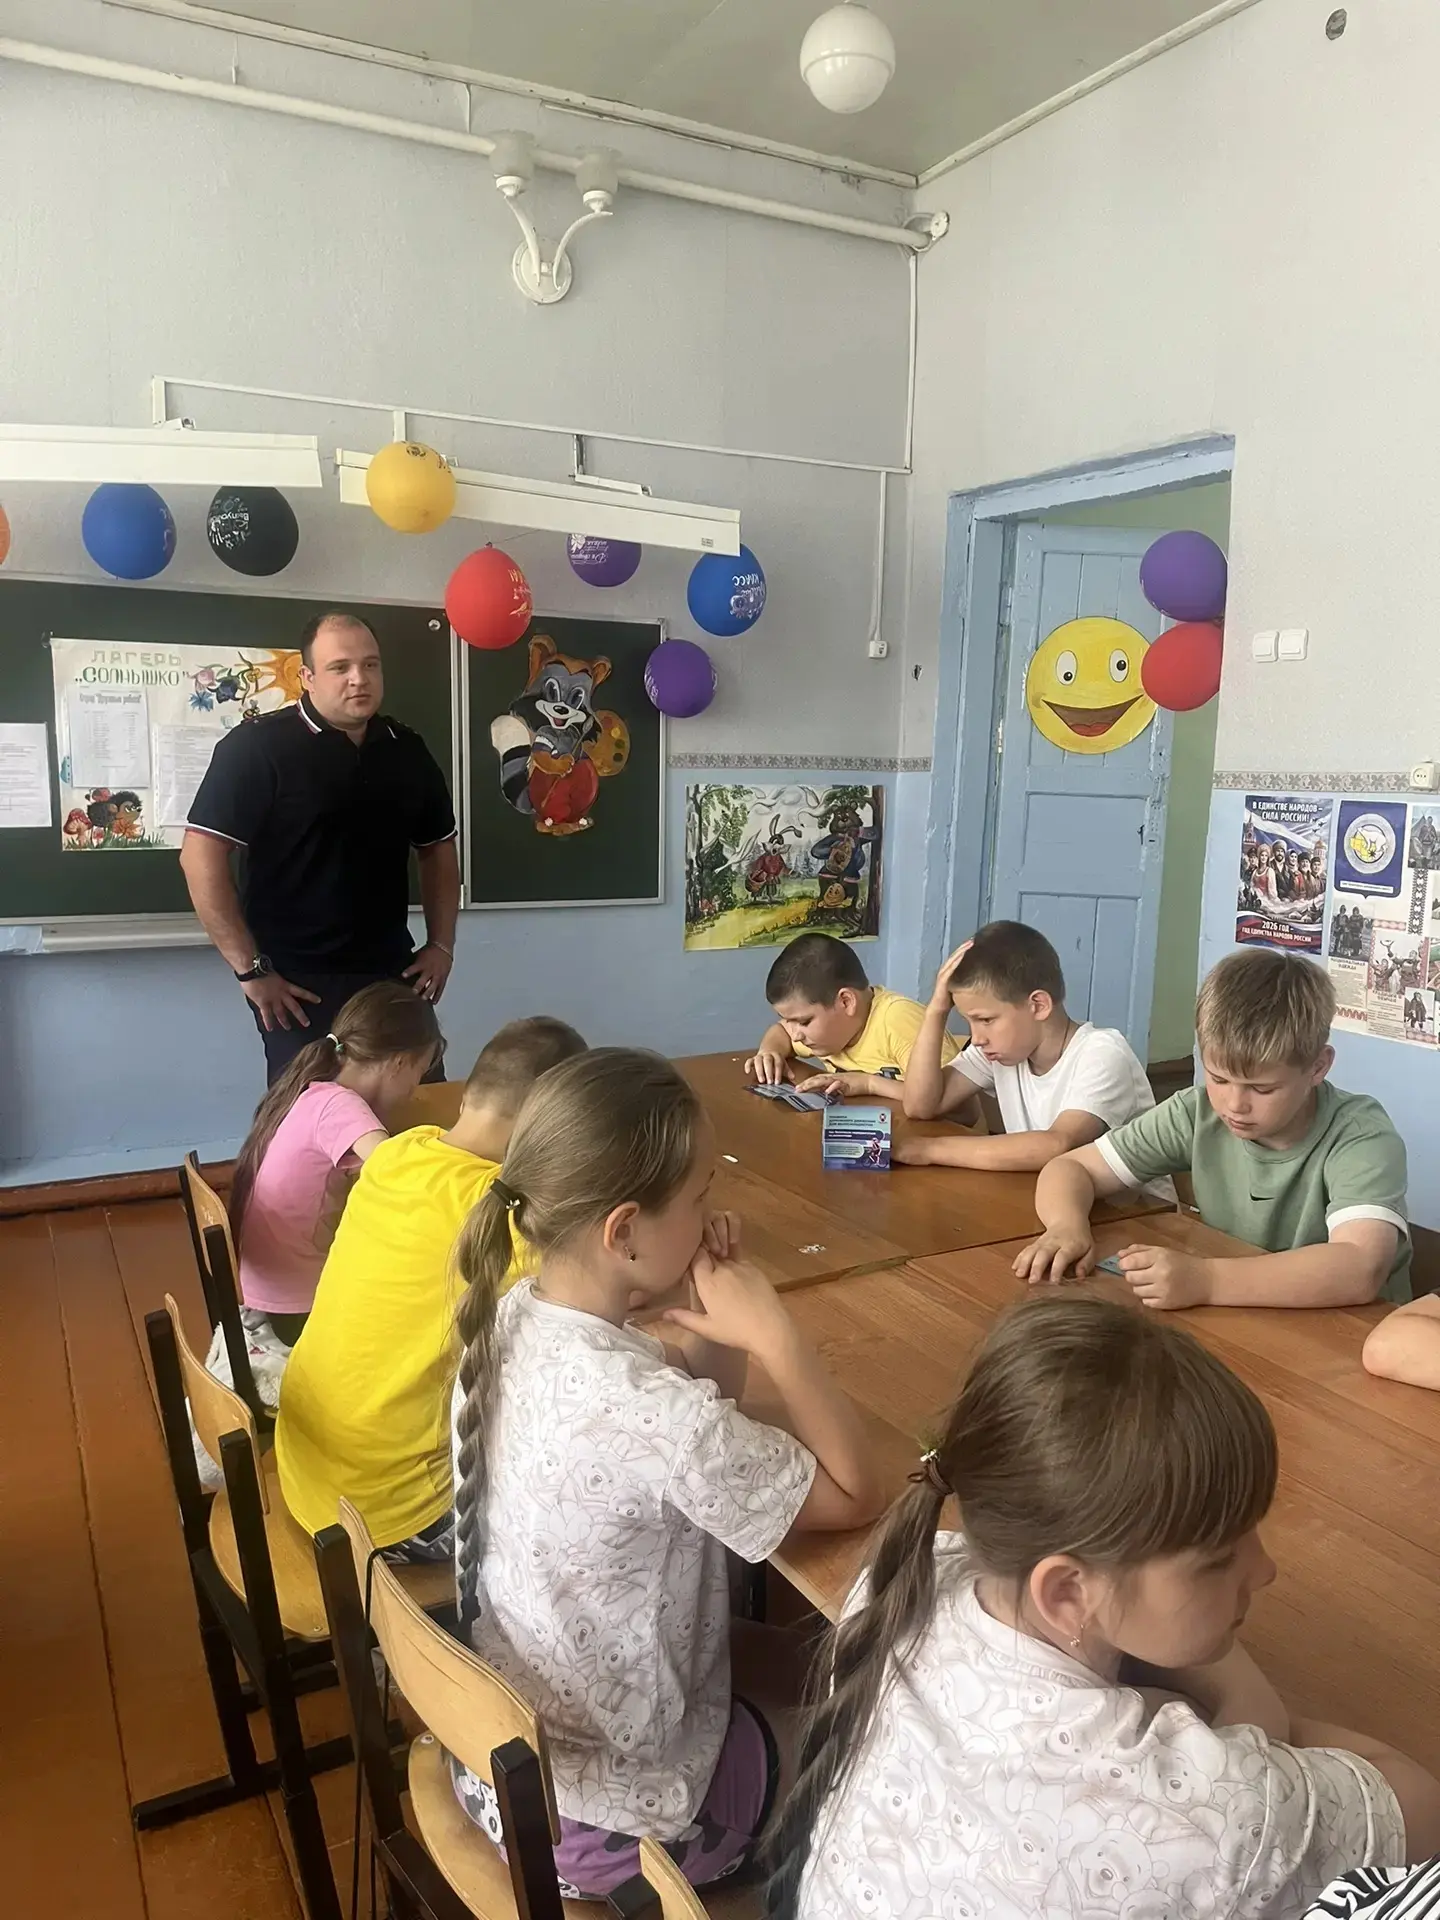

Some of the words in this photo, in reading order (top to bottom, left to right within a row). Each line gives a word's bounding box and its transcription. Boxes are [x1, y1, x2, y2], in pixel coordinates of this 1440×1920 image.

[91, 650, 181, 667] ЛАГЕРЬ
[1252, 801, 1257, 809] В
[1258, 802, 1288, 811] ЕДИНСТВЕ
[1288, 803, 1318, 813] НАРОДОВ
[1262, 811, 1279, 820] СИЛА
[1280, 812, 1310, 822] РОССИИ!
[1262, 921, 1278, 930] 2026
[1278, 924, 1289, 933] ГОД
[1293, 934, 1312, 942] РОССИИ
